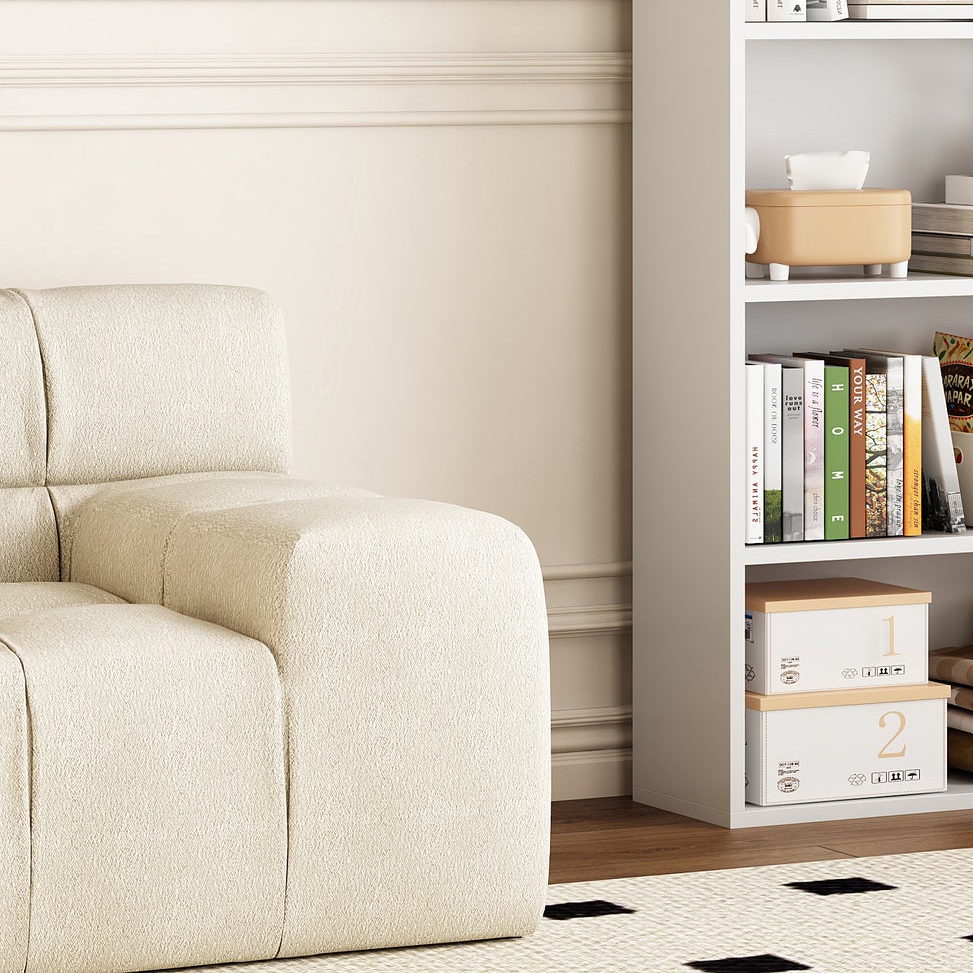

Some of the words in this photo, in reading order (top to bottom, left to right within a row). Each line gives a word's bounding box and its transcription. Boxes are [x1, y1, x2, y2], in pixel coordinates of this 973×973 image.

[808, 378, 822, 389] life
[853, 367, 863, 404] YOUR
[808, 406, 822, 428] flower
[853, 408, 863, 436] WAY
[831, 384, 844, 522] HOME
[882, 615, 901, 656] 1
[878, 710, 906, 759] 2
